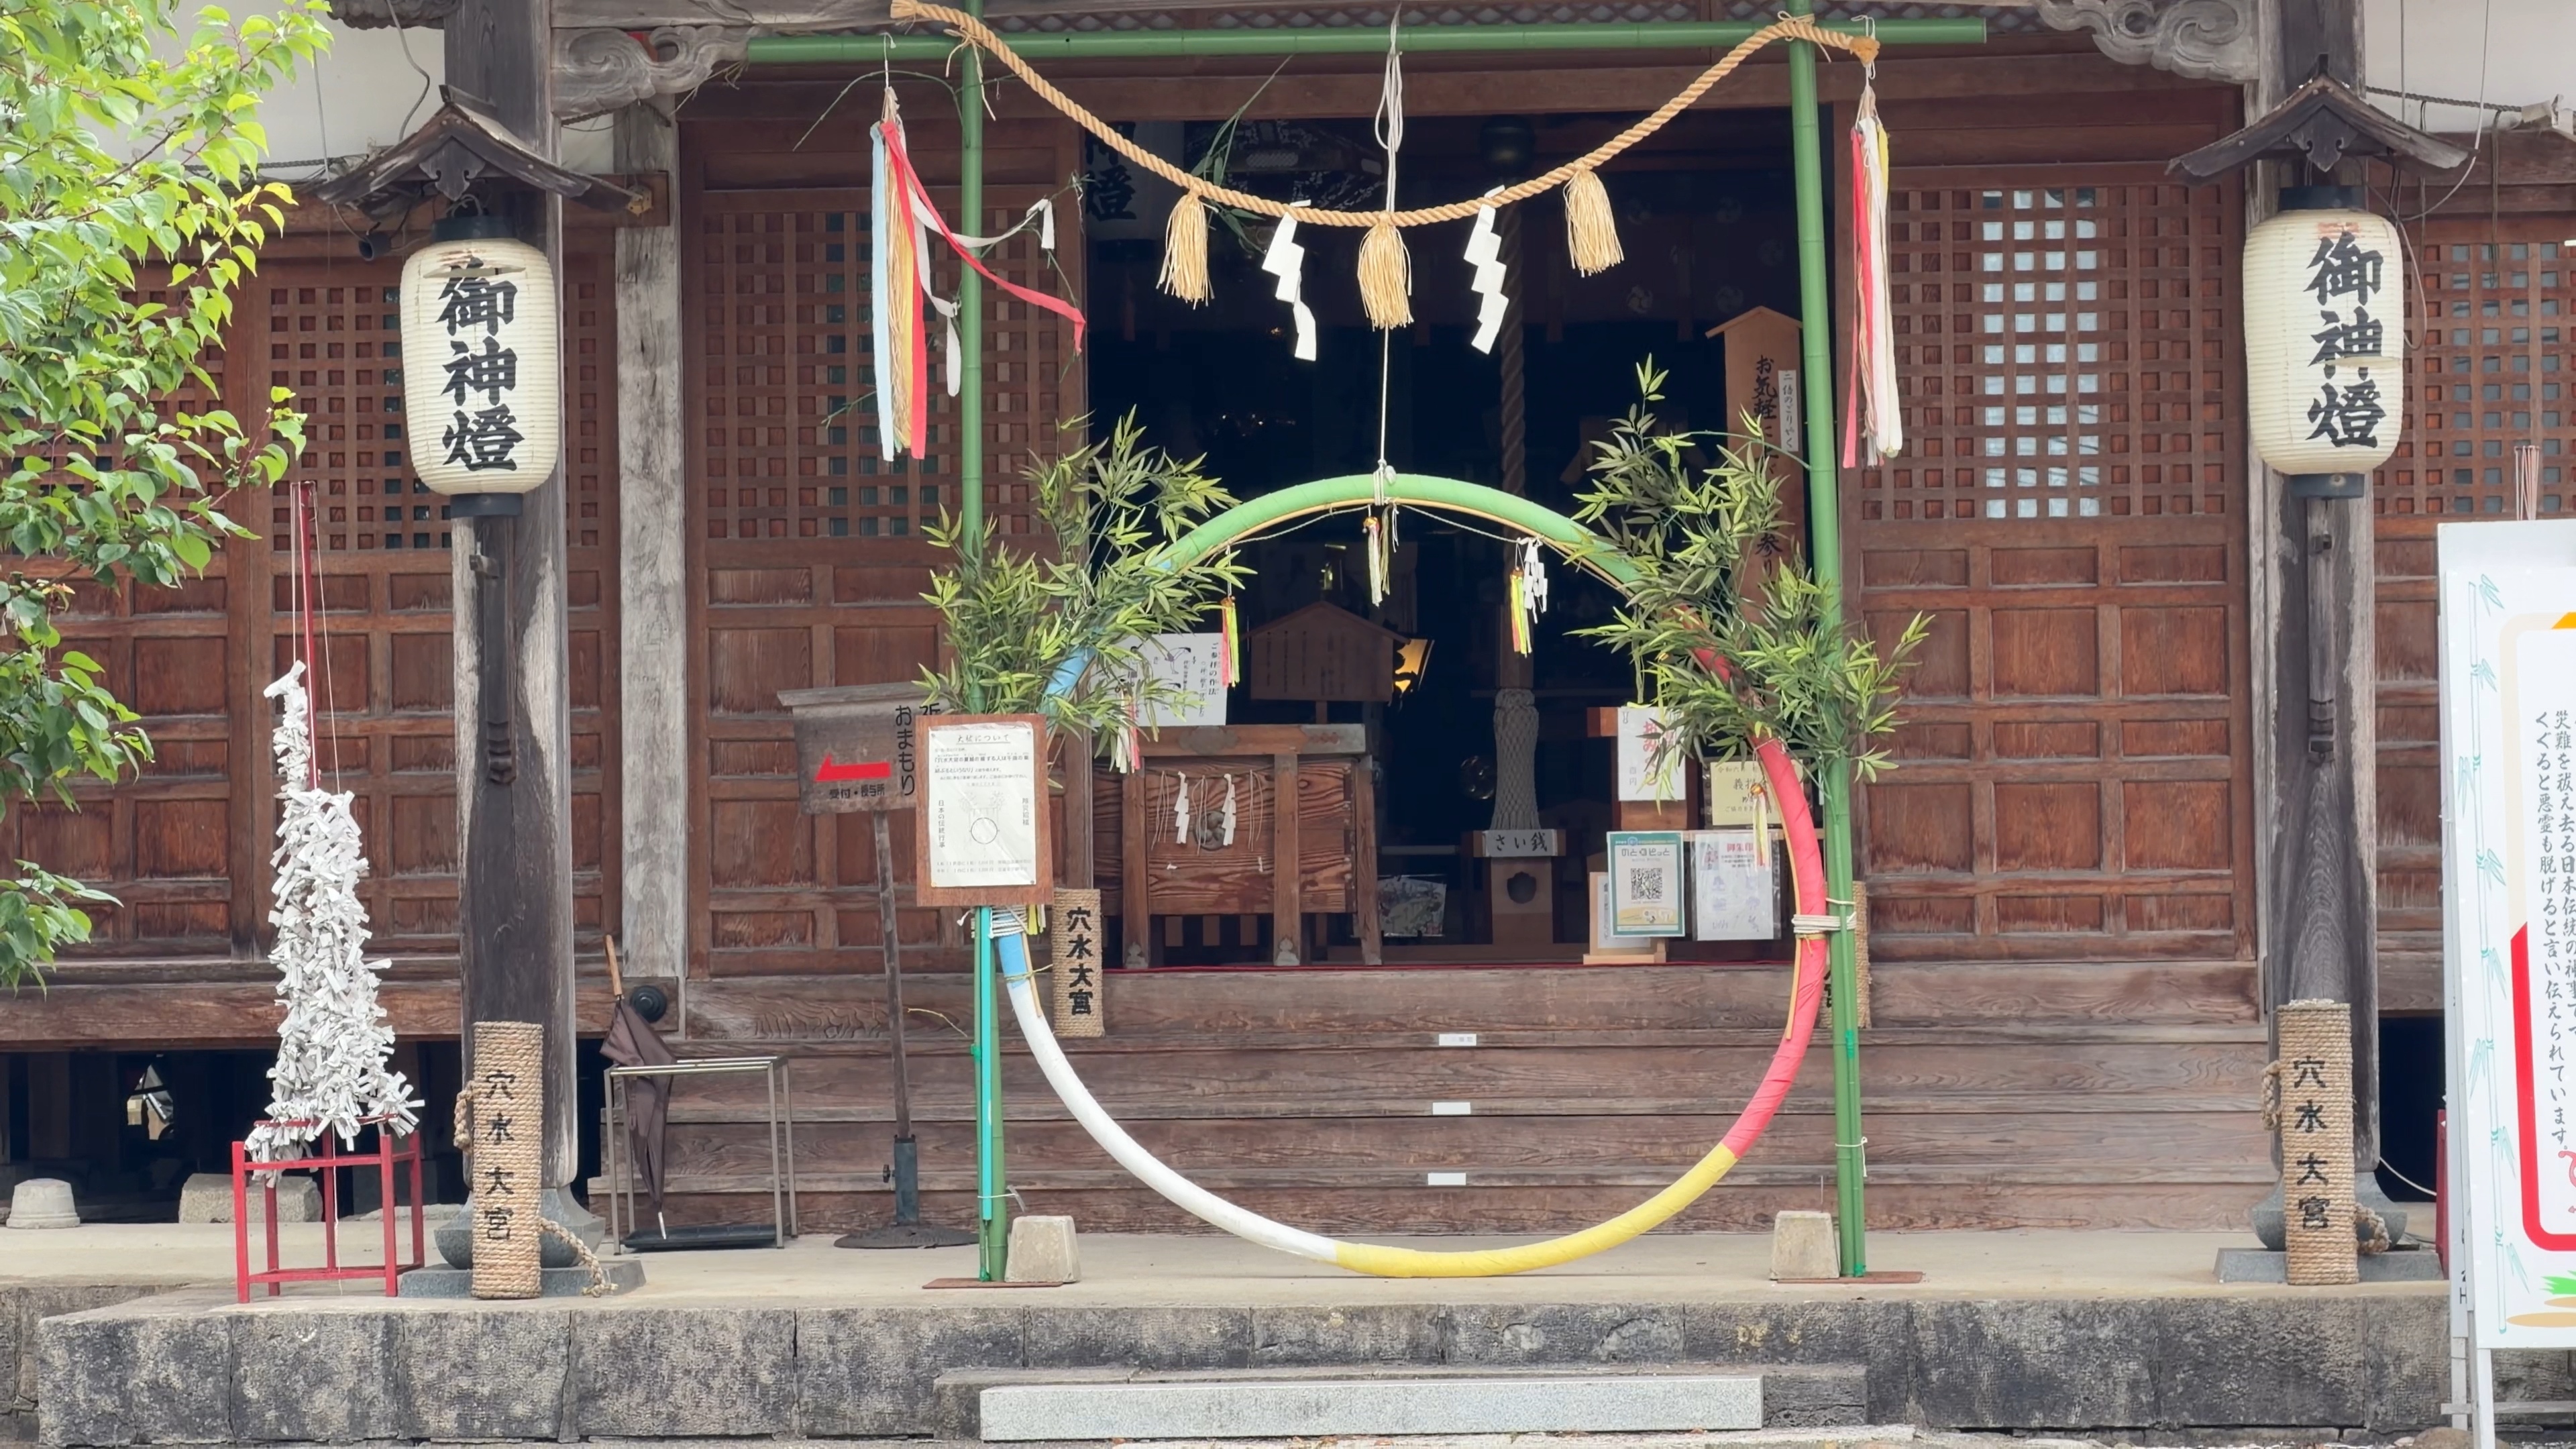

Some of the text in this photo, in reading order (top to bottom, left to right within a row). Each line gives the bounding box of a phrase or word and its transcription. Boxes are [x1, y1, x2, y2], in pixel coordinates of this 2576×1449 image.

[435, 256, 525, 472] 御神燈
[2304, 231, 2387, 449] 御神燈
[829, 784, 885, 799] 受付・授与所
[895, 704, 916, 796] おまもり
[1495, 831, 1548, 852] さい銭
[1066, 906, 1093, 1016] 穴水大宮
[2535, 711, 2569, 1150] くぐると悪霊も脱げると言い伝えられています。
[484, 1069, 517, 1241] 穴水大宮
[2293, 1055, 2330, 1230] 穴水大宮
